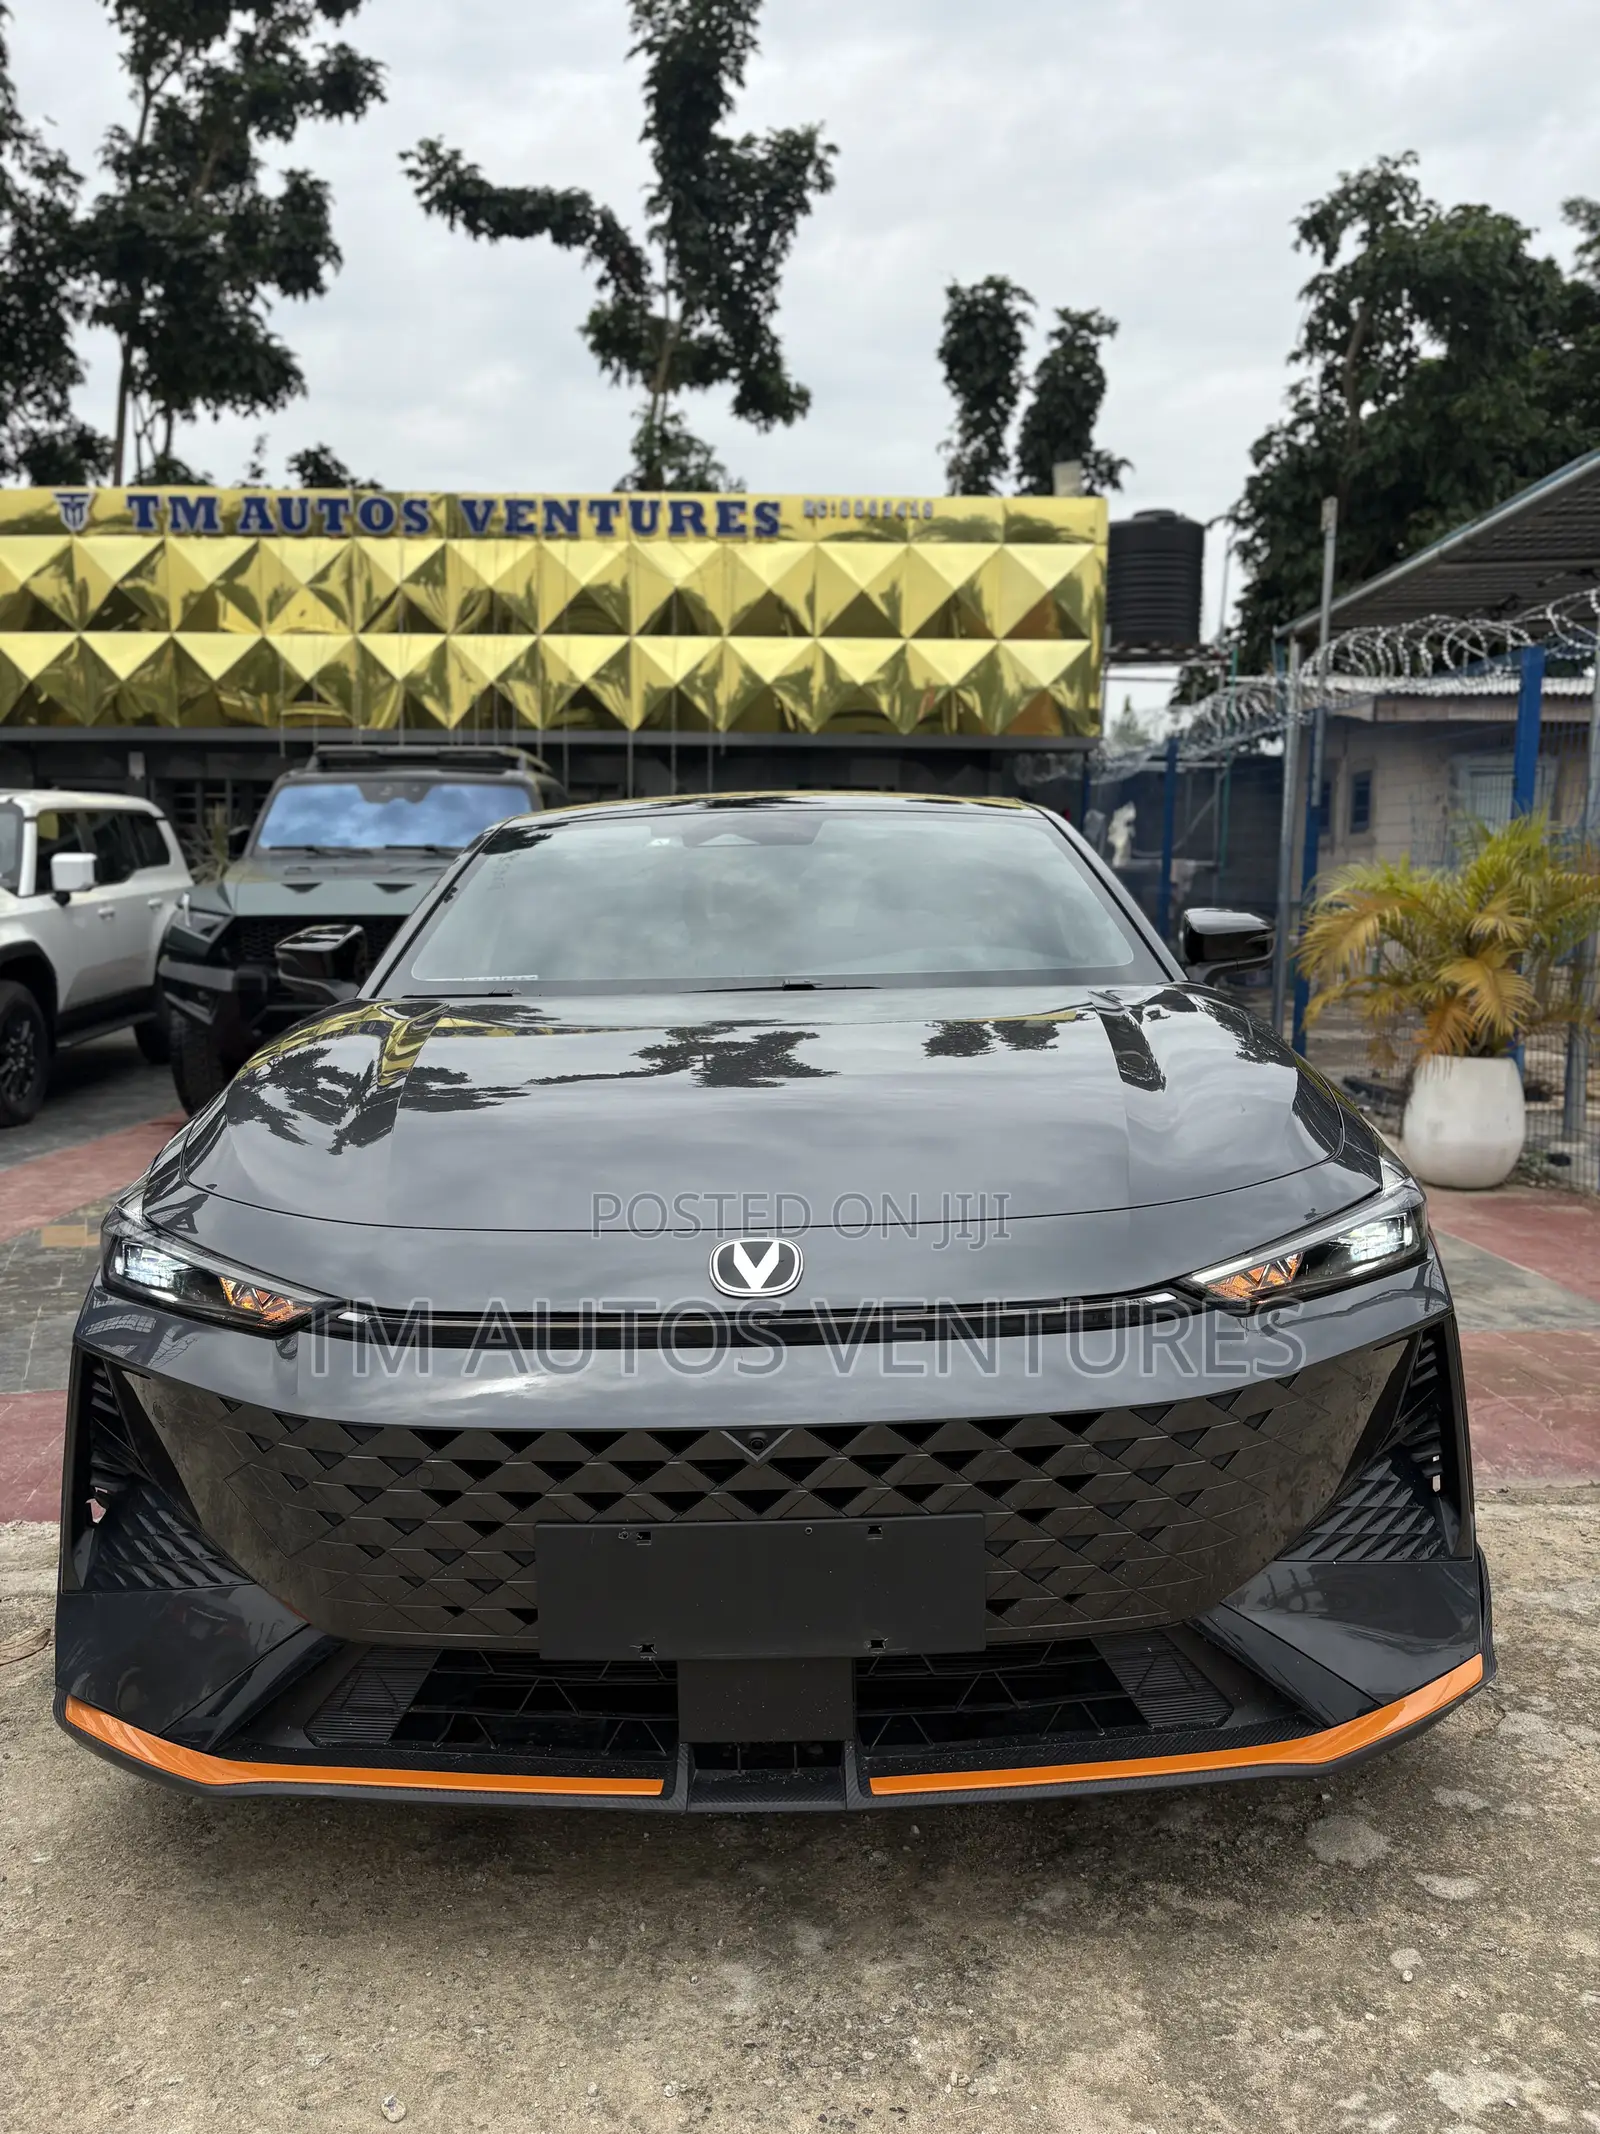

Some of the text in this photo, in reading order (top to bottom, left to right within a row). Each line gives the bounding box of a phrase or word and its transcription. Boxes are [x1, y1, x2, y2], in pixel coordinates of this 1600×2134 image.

[126, 494, 782, 537] TM AUTOS VENTURES
